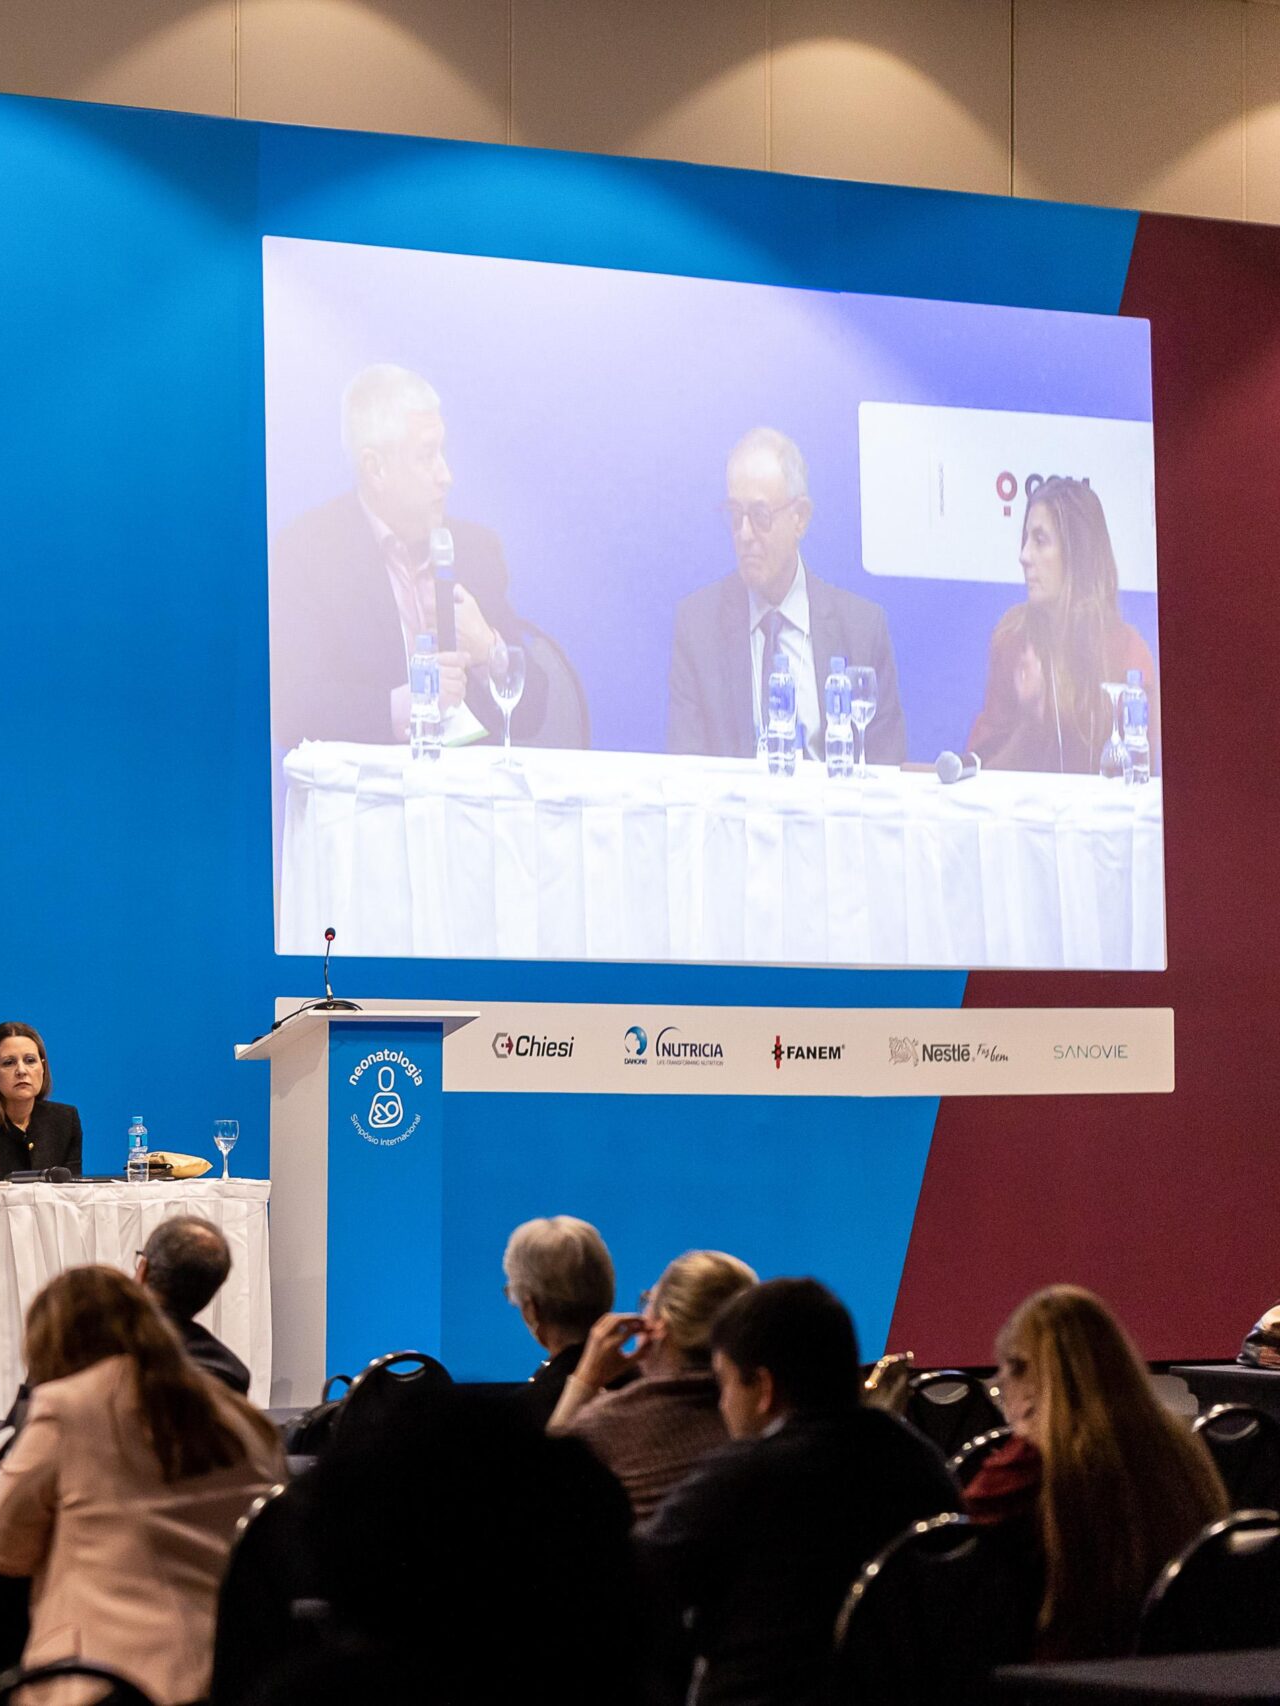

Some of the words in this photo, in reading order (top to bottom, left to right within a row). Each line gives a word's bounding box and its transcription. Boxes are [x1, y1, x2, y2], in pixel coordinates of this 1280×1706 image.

[515, 1035, 575, 1058] Chiesi
[661, 1043, 724, 1058] NUTRICIA
[786, 1046, 841, 1060] FANEM
[922, 1043, 971, 1062] Nestlé
[990, 1045, 1009, 1062] bem
[1053, 1045, 1128, 1060] SANOVIE
[348, 1048, 423, 1086] neonatologia
[350, 1113, 379, 1145] Simpósio
[380, 1114, 422, 1146] Internacional
